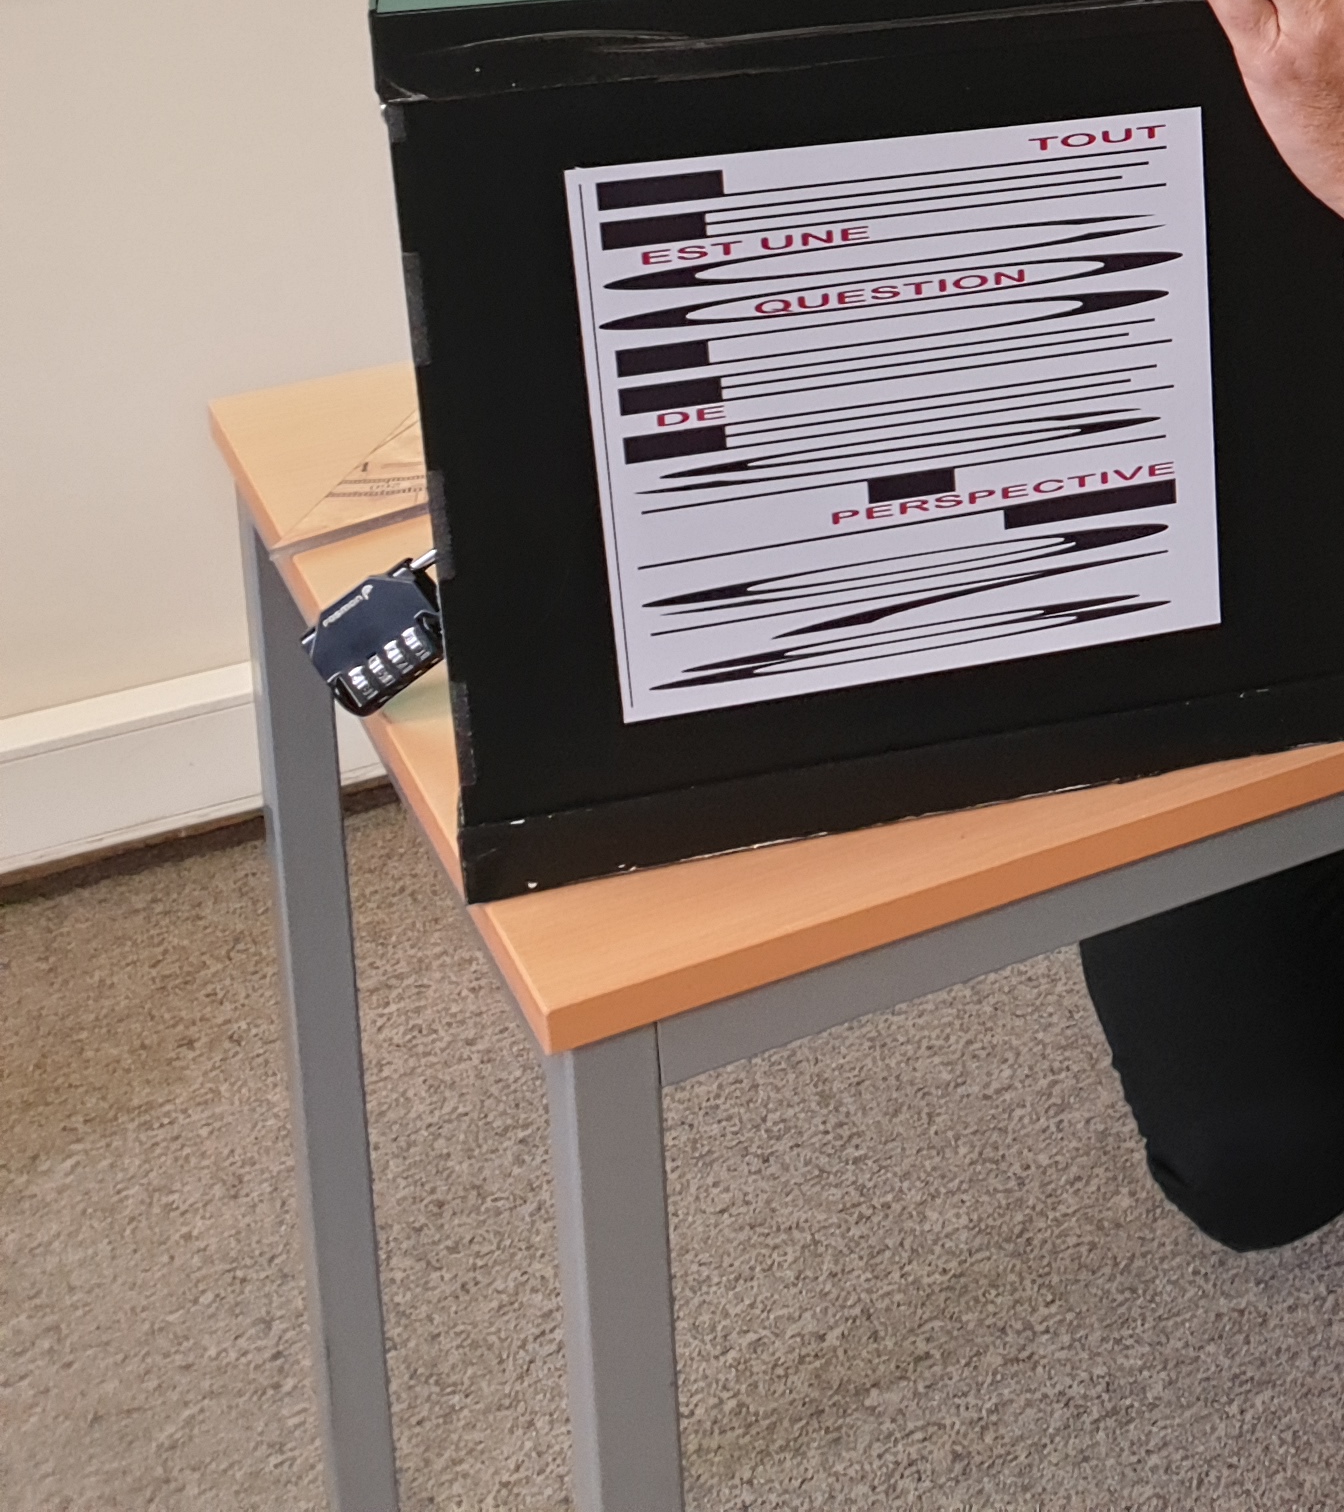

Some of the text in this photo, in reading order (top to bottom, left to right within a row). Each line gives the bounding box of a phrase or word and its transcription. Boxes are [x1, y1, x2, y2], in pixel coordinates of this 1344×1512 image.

[1028, 125, 1168, 151] TOUT
[640, 225, 872, 266] EST UNE
[753, 268, 1028, 316] QUESTION
[655, 404, 727, 428] DE
[831, 460, 1178, 527] PERSPECTIVE
